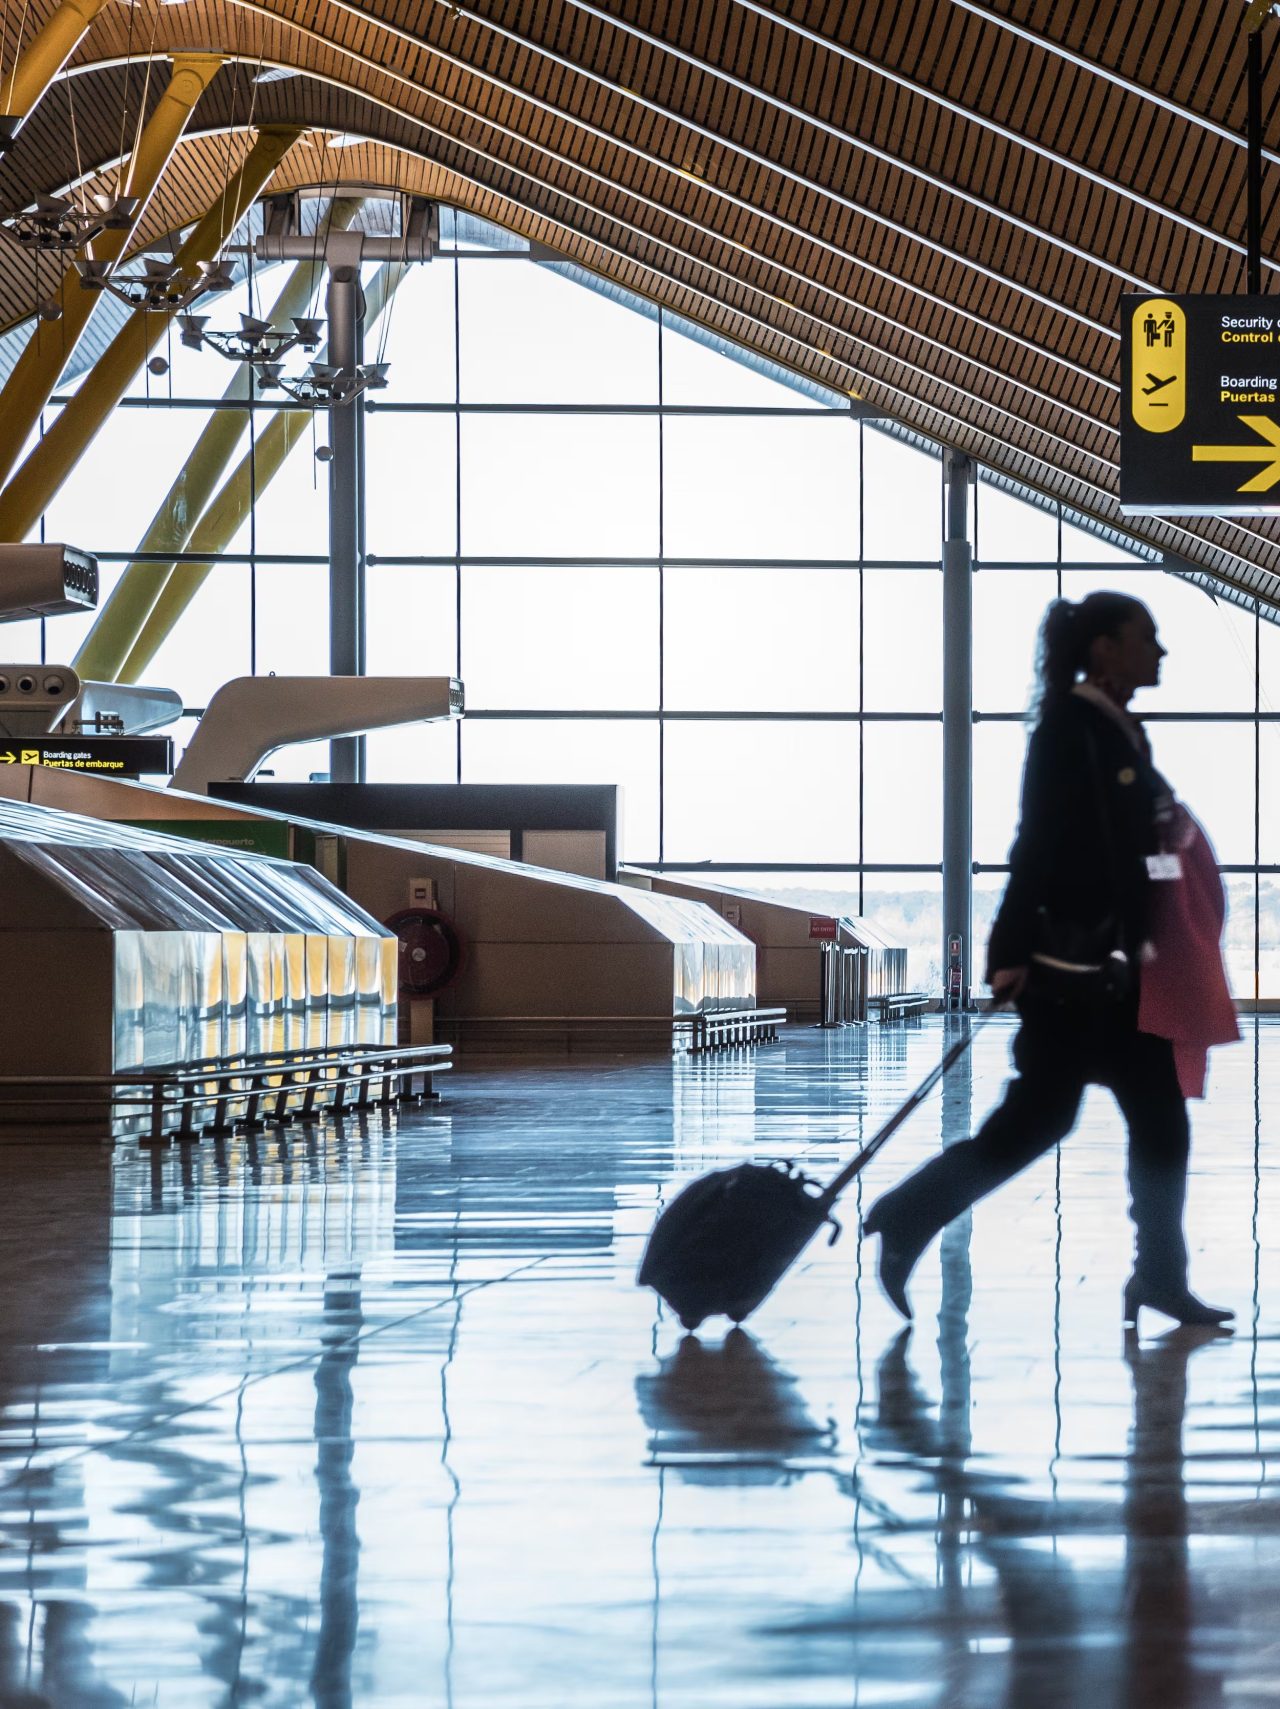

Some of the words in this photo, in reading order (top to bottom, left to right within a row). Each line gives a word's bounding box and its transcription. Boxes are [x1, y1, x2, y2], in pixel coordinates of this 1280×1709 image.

[1221, 316, 1273, 330] Security
[1221, 331, 1273, 343] Control
[1220, 375, 1277, 390] Boarding
[1220, 391, 1275, 403] Puertas
[43, 751, 72, 759] Boarding
[73, 751, 92, 759] gates
[43, 760, 73, 768] Puertas
[75, 760, 85, 768] de
[86, 760, 124, 769] embarque
